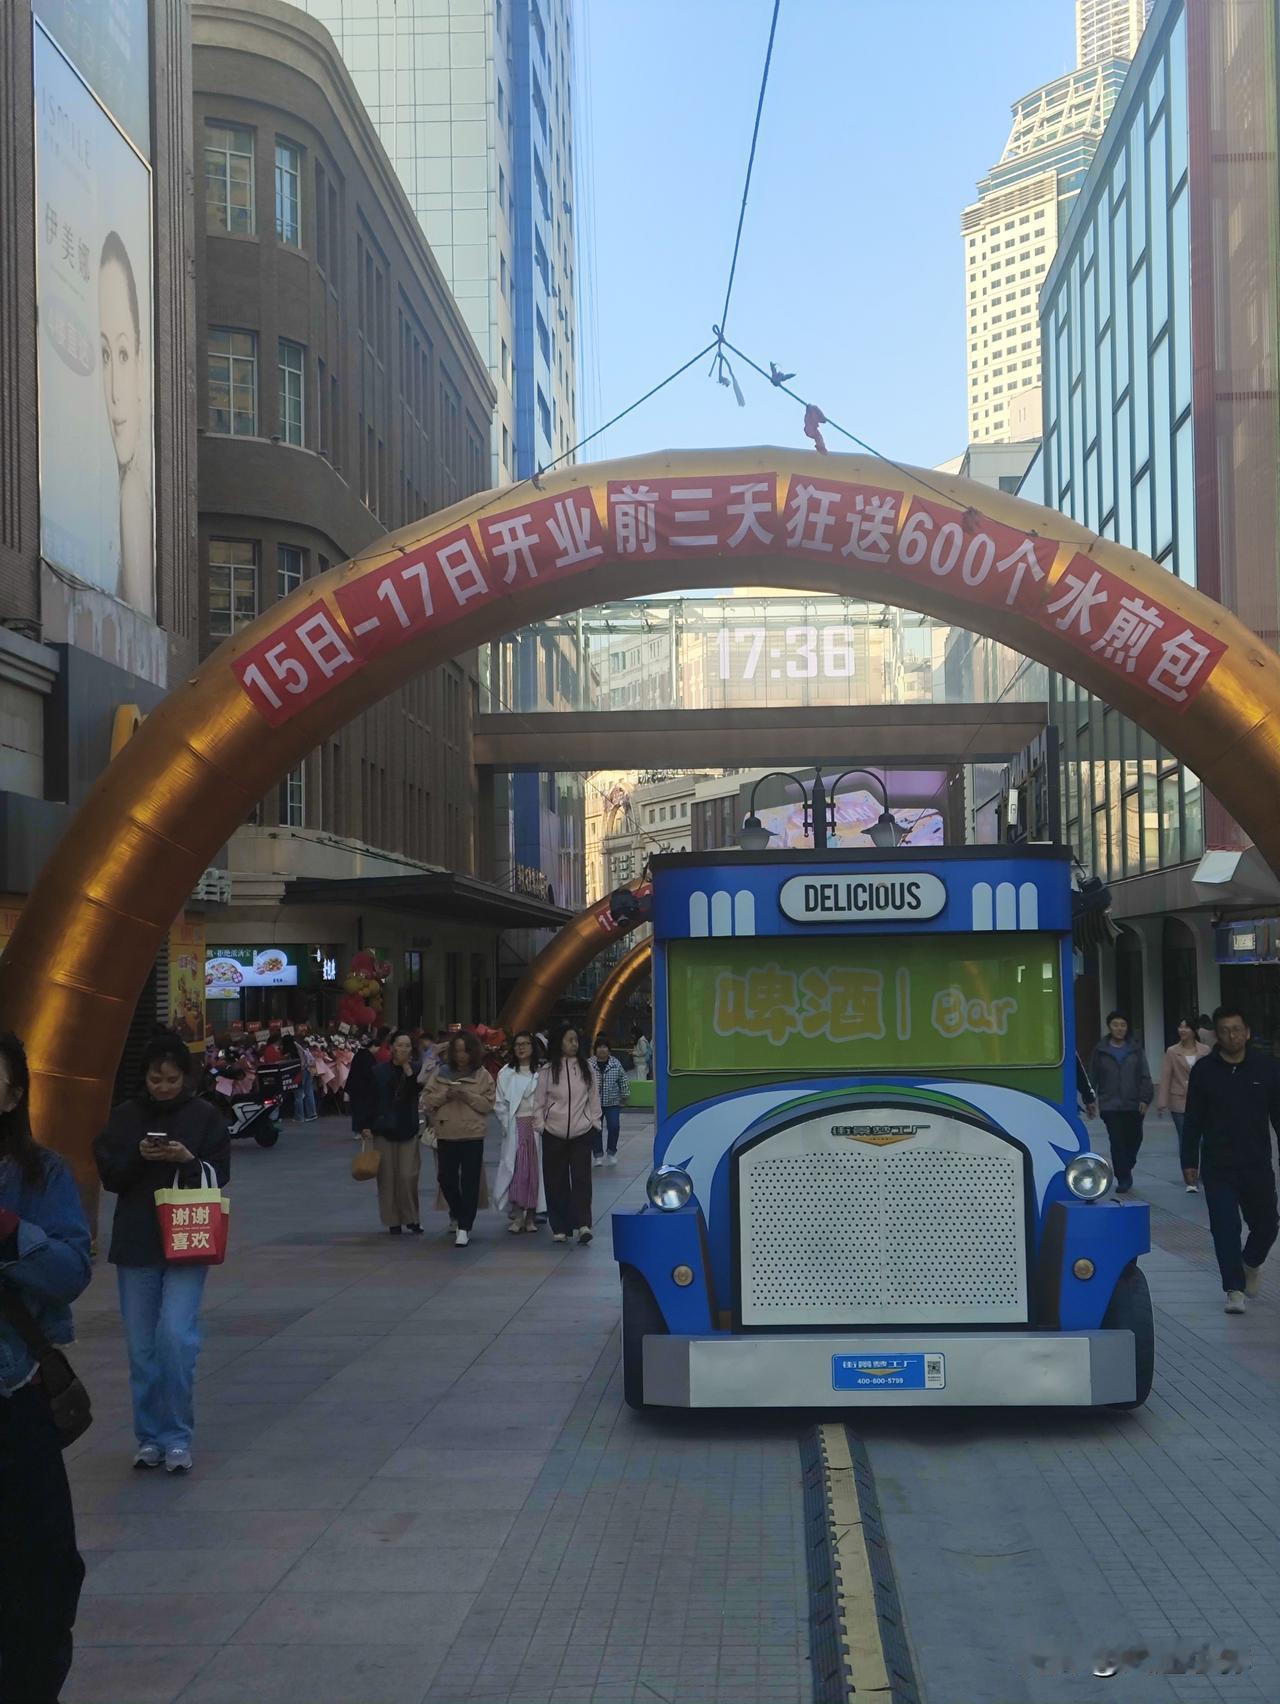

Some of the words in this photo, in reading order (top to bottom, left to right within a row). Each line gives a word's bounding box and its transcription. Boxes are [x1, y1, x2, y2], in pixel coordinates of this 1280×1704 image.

[717, 625, 856, 680] 17:36
[804, 881, 922, 913] DELICIOUS
[713, 962, 886, 1046] 啤酒
[171, 1206, 210, 1226] 谢谢
[171, 1231, 210, 1251] 喜欢
